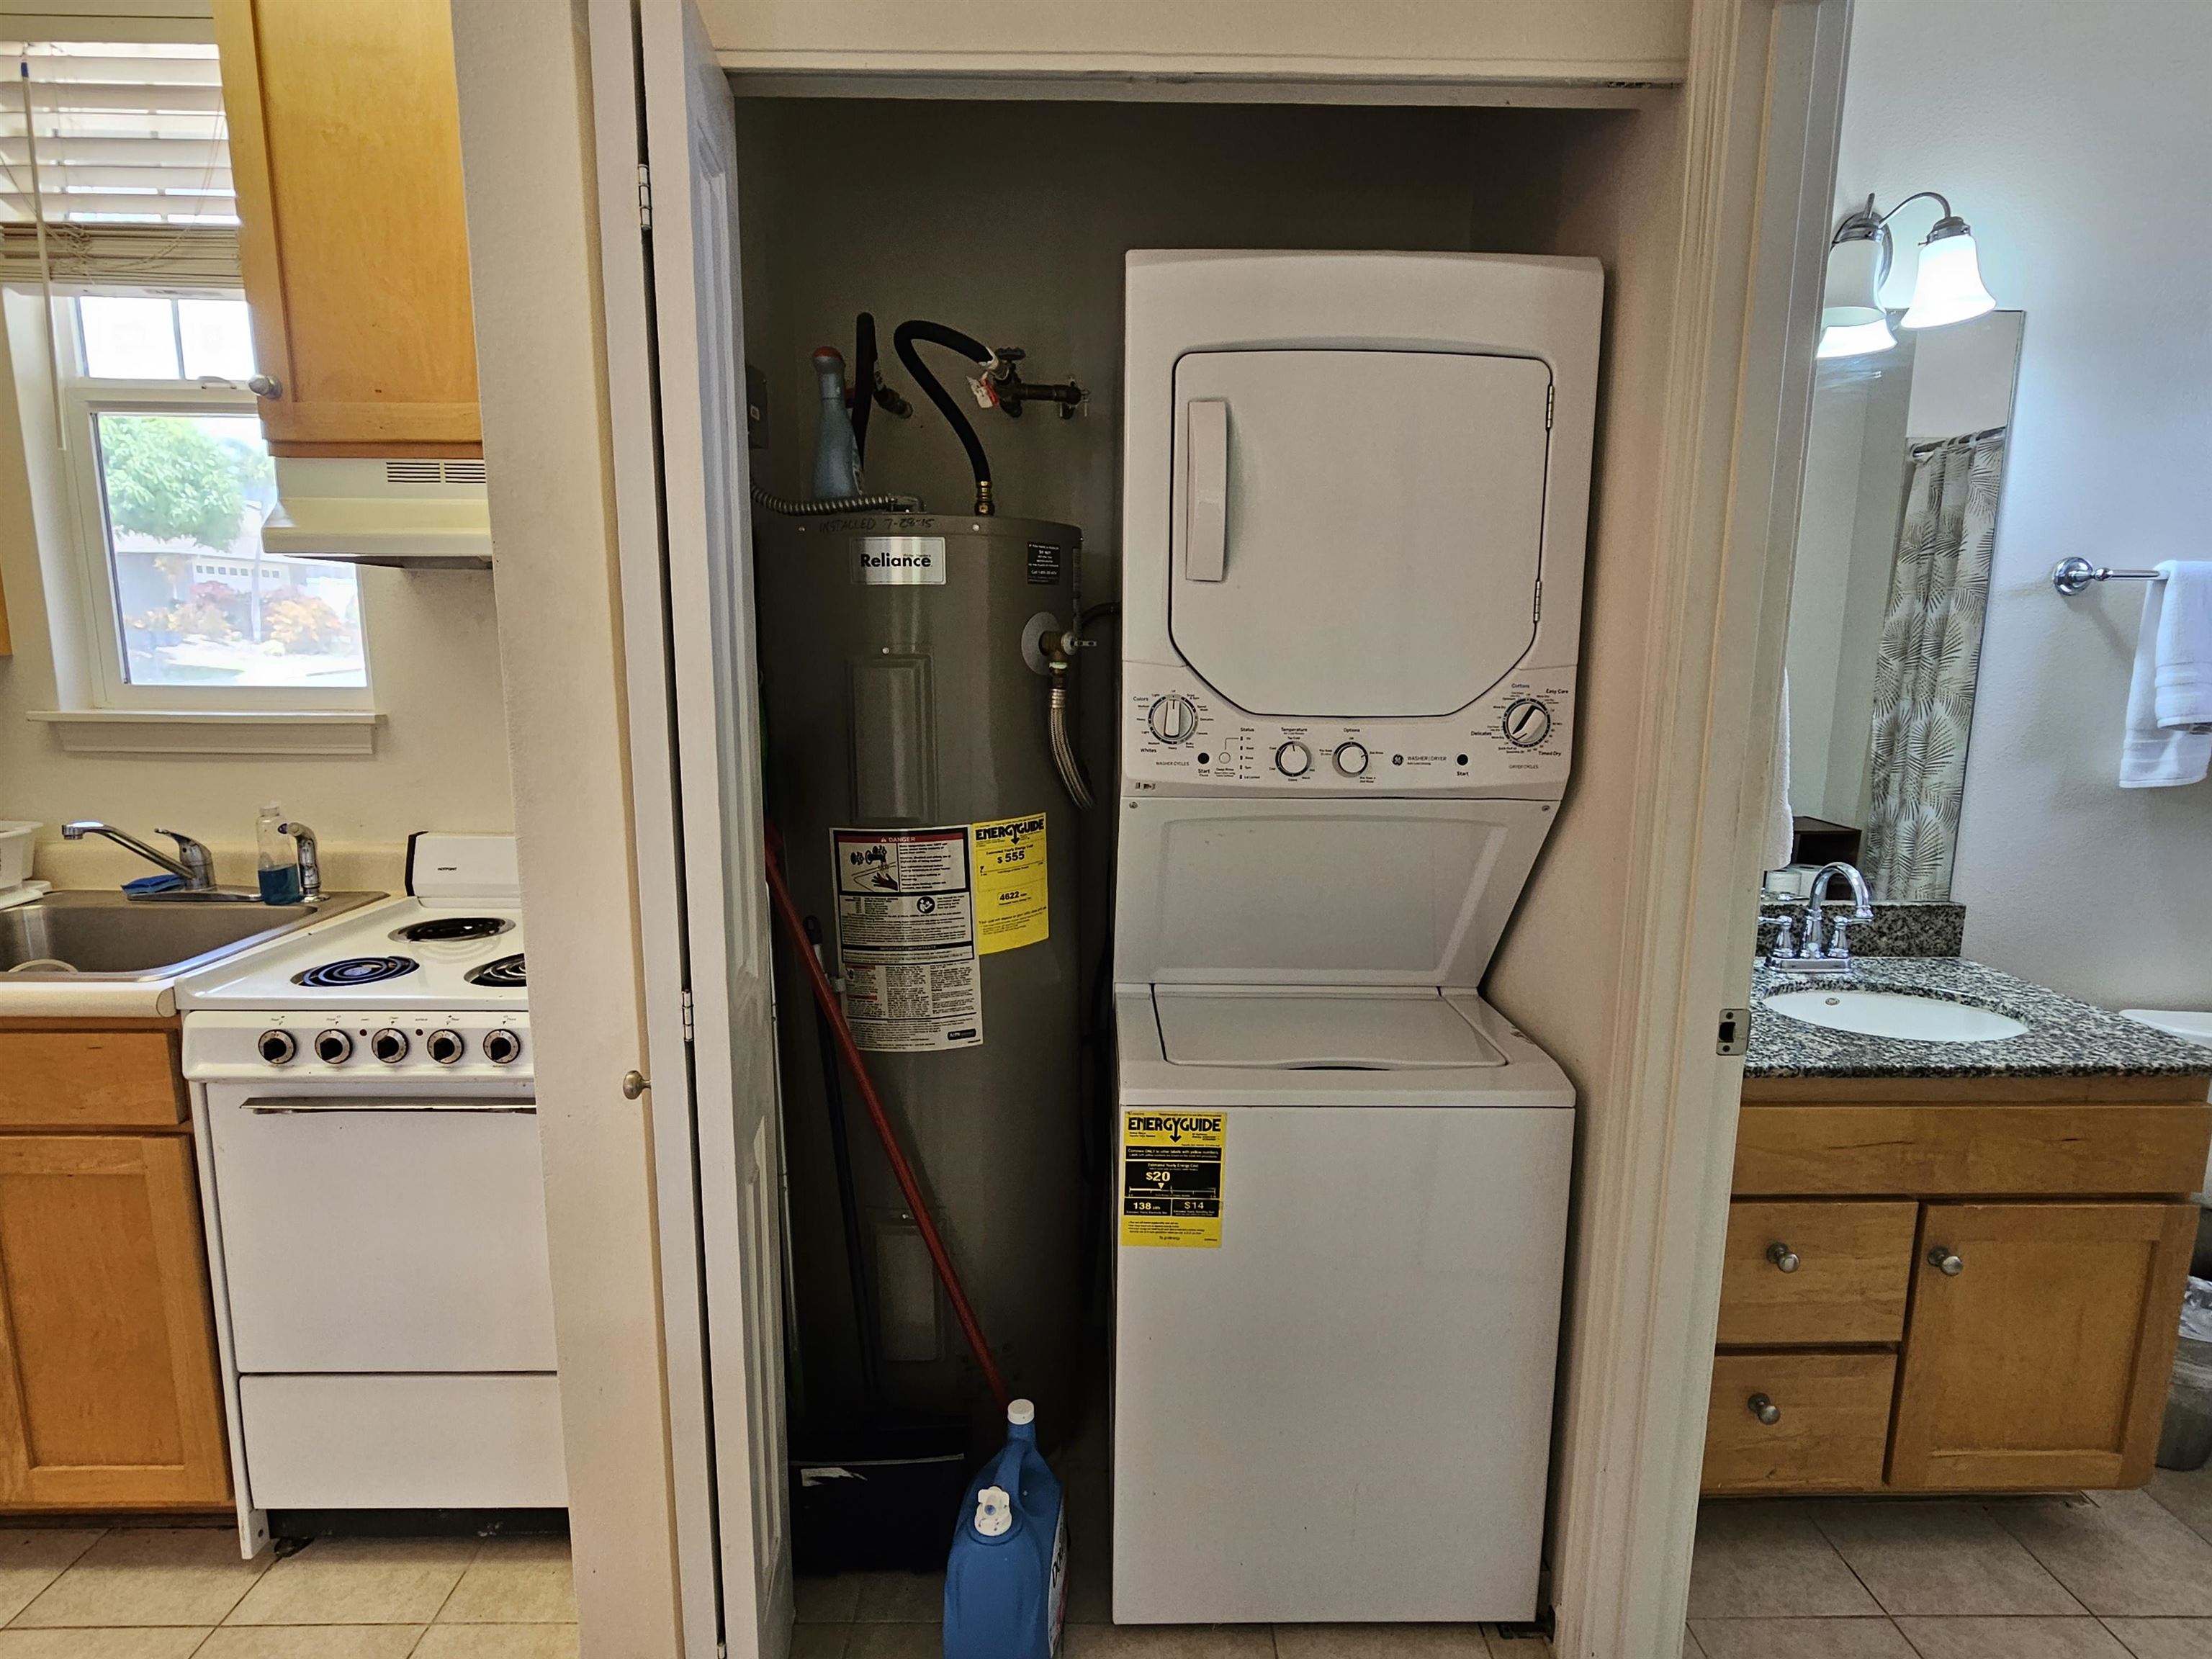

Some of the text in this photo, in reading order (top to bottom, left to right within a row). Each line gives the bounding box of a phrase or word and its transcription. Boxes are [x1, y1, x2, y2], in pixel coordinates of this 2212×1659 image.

[819, 518, 876, 533] INSTALLED
[860, 553, 931, 567] Reliance
[975, 819, 1044, 841] ENERGYGUIDE
[1005, 850, 1025, 863] 555
[999, 891, 1020, 901] 4622
[1128, 1117, 1221, 1132] ENERGYGUIDE
[1146, 1172, 1170, 1182] $20
